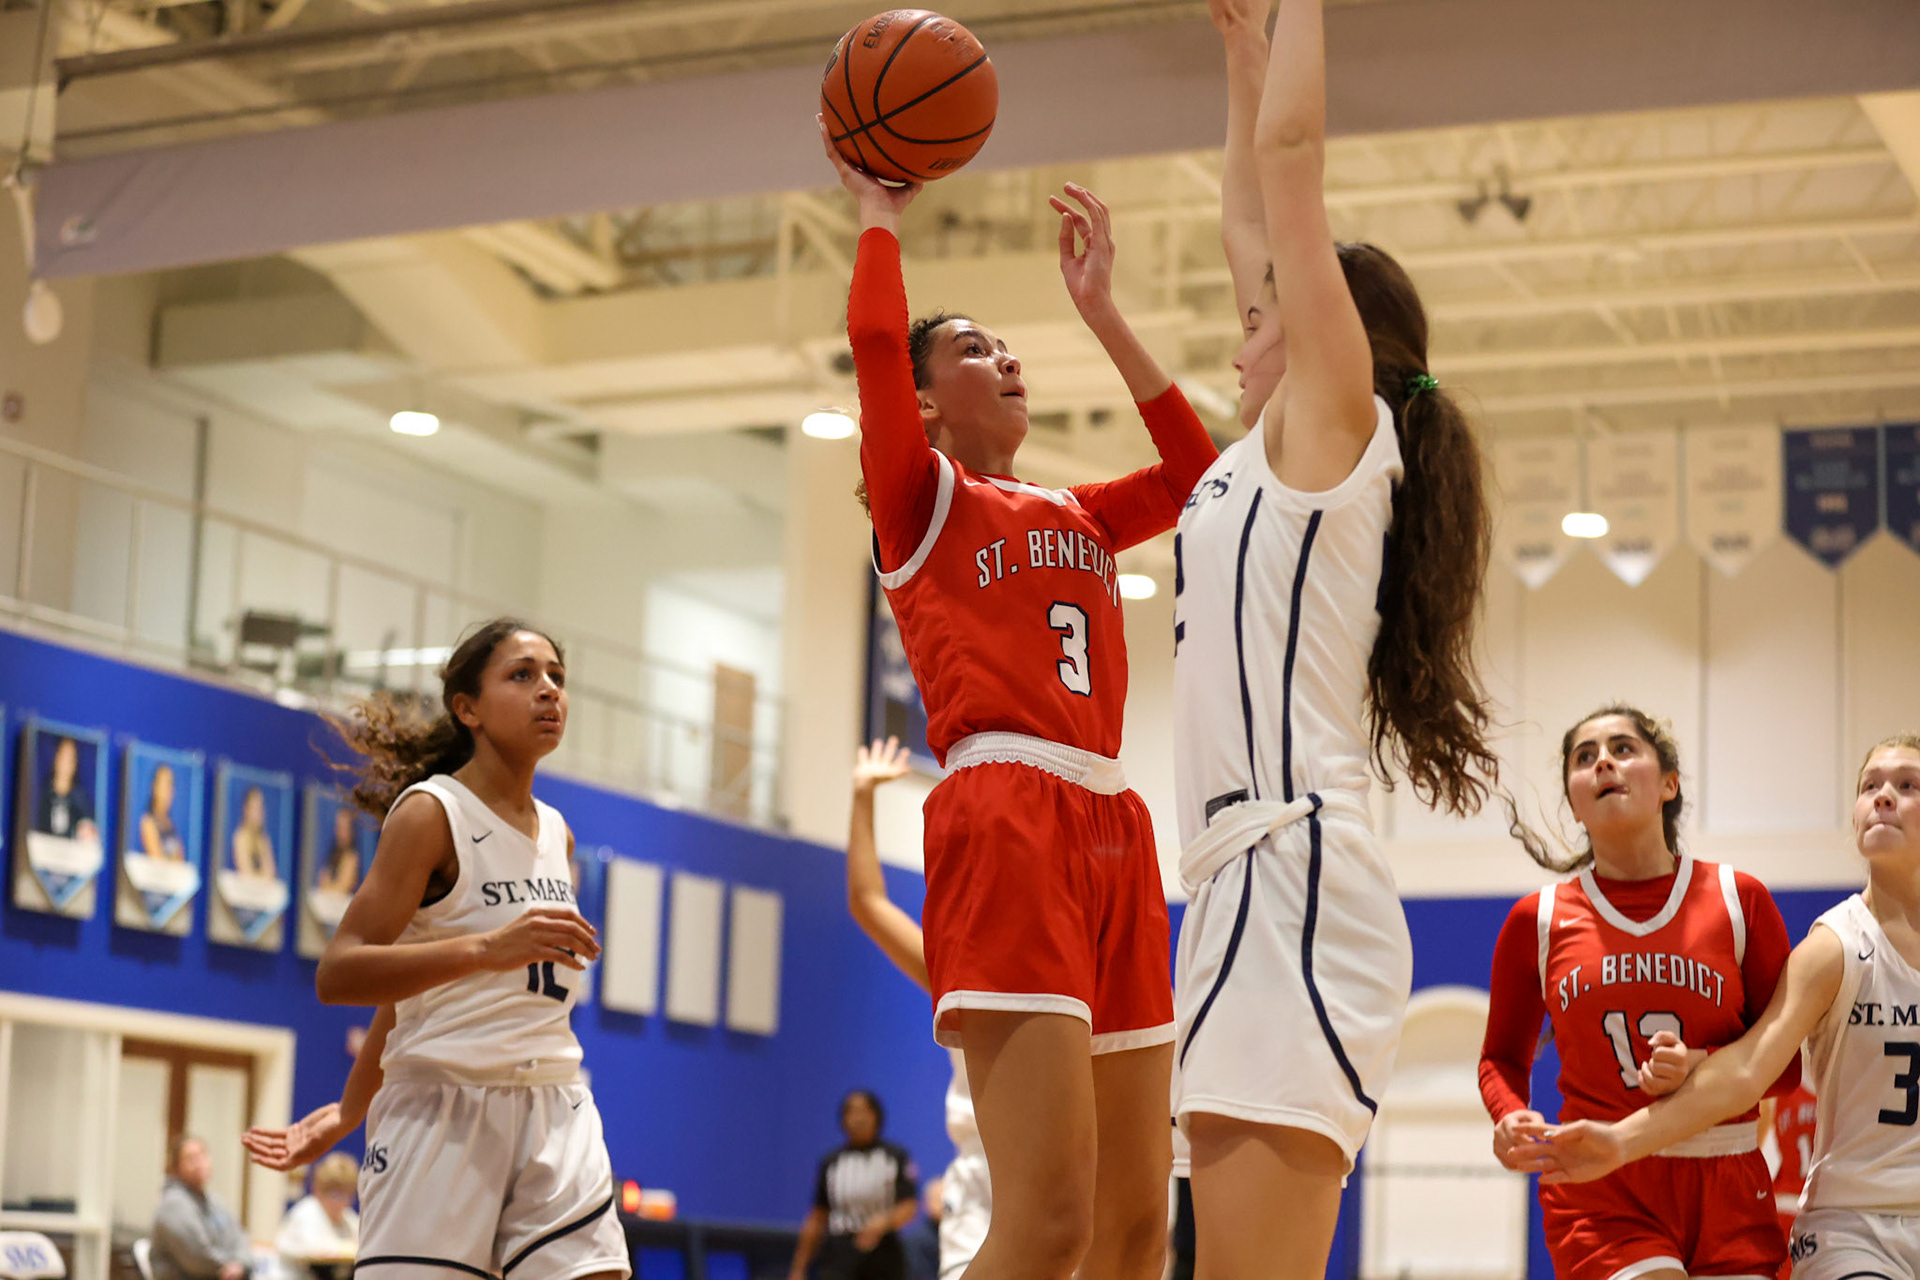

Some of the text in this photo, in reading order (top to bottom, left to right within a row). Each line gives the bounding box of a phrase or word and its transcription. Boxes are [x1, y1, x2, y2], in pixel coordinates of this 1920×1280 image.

[975, 529, 1119, 609] ST. BENEDICT
[1047, 600, 1092, 698] 3
[481, 877, 575, 906] ST. MAR
[1558, 952, 1726, 1013] ST. BENEDICT
[1848, 1002, 1885, 1026] ST.
